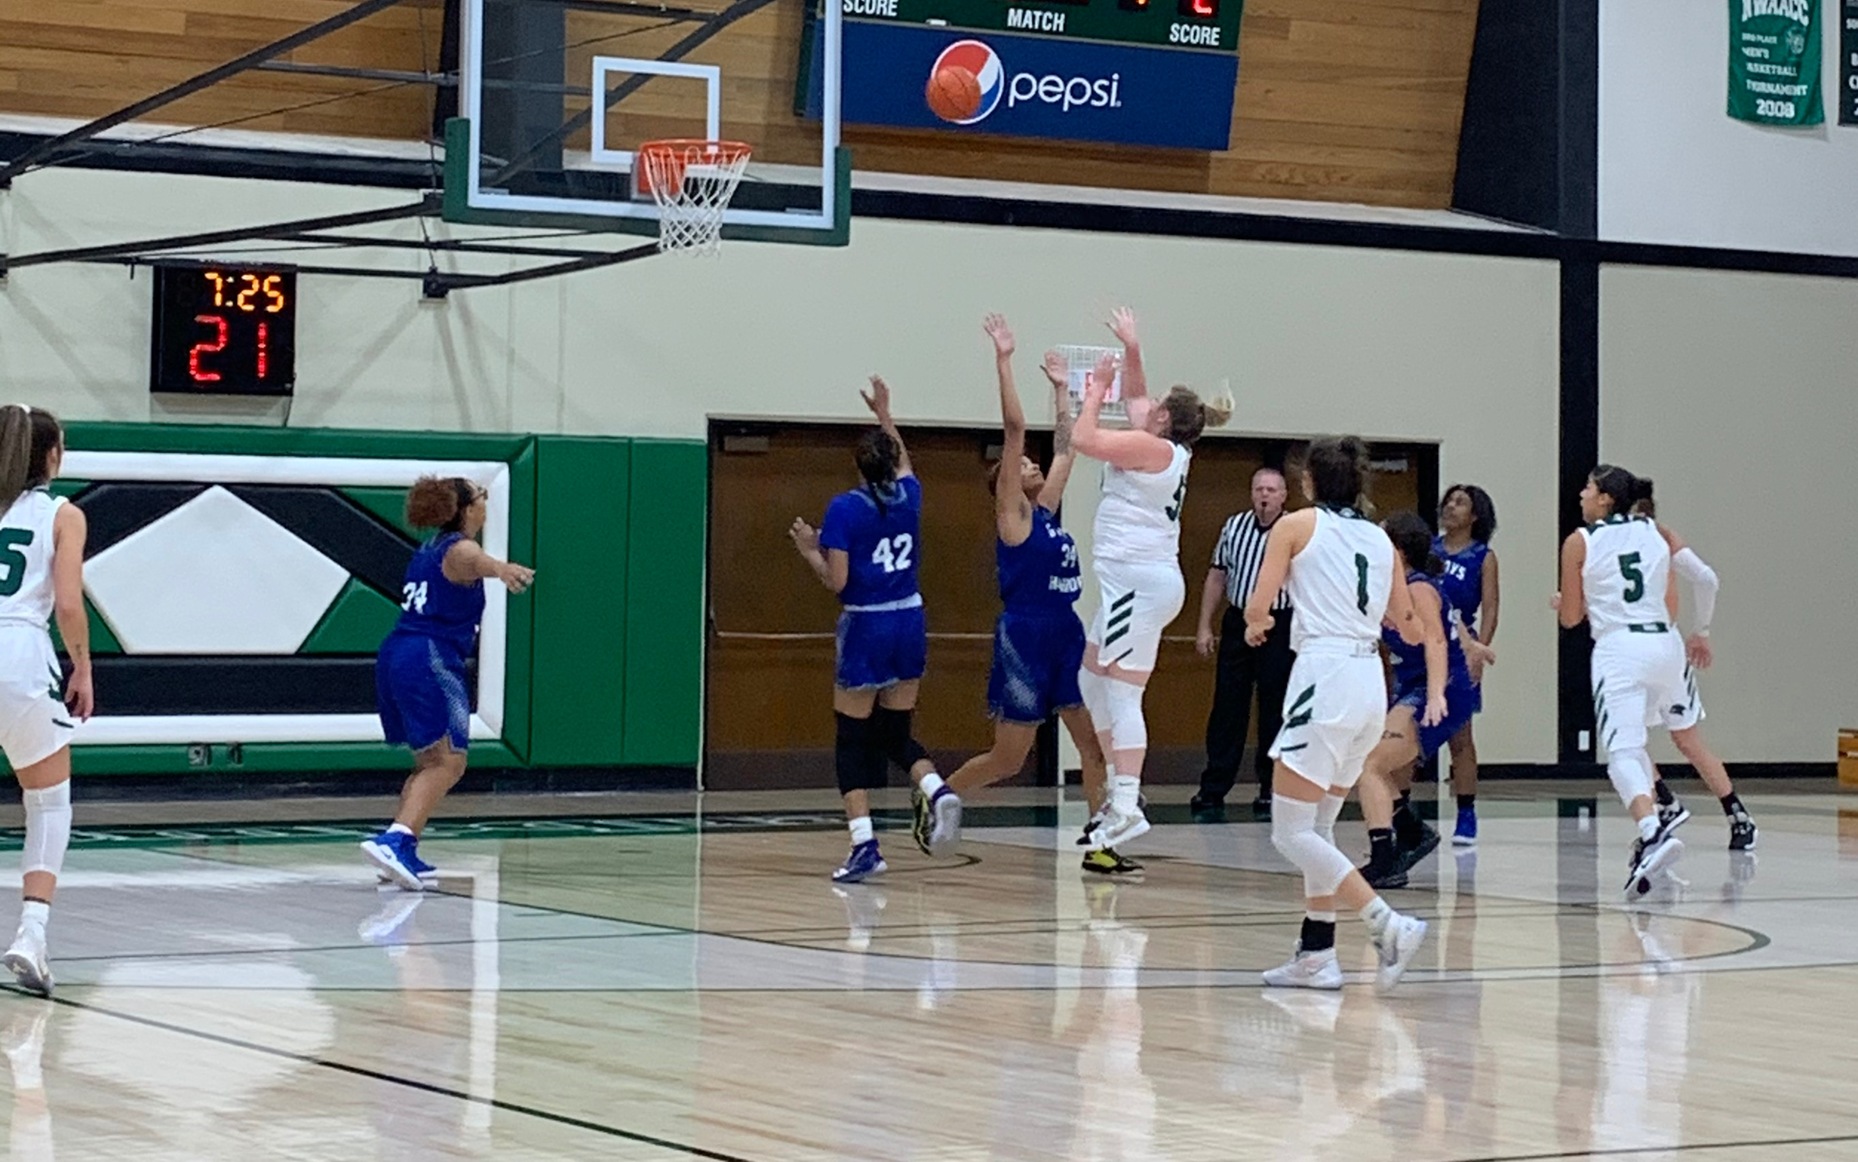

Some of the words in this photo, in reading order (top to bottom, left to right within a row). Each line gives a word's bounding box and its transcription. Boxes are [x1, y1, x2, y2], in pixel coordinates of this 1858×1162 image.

[843, 0, 898, 16] SCORE
[1007, 8, 1066, 32] MATCH
[1169, 22, 1221, 46] SCORE
[1008, 73, 1120, 112] pepsi
[204, 271, 284, 313] 7:25
[189, 314, 267, 381] 21
[872, 532, 913, 573] 42
[1354, 552, 1369, 616] 1
[1618, 551, 1644, 604] 5
